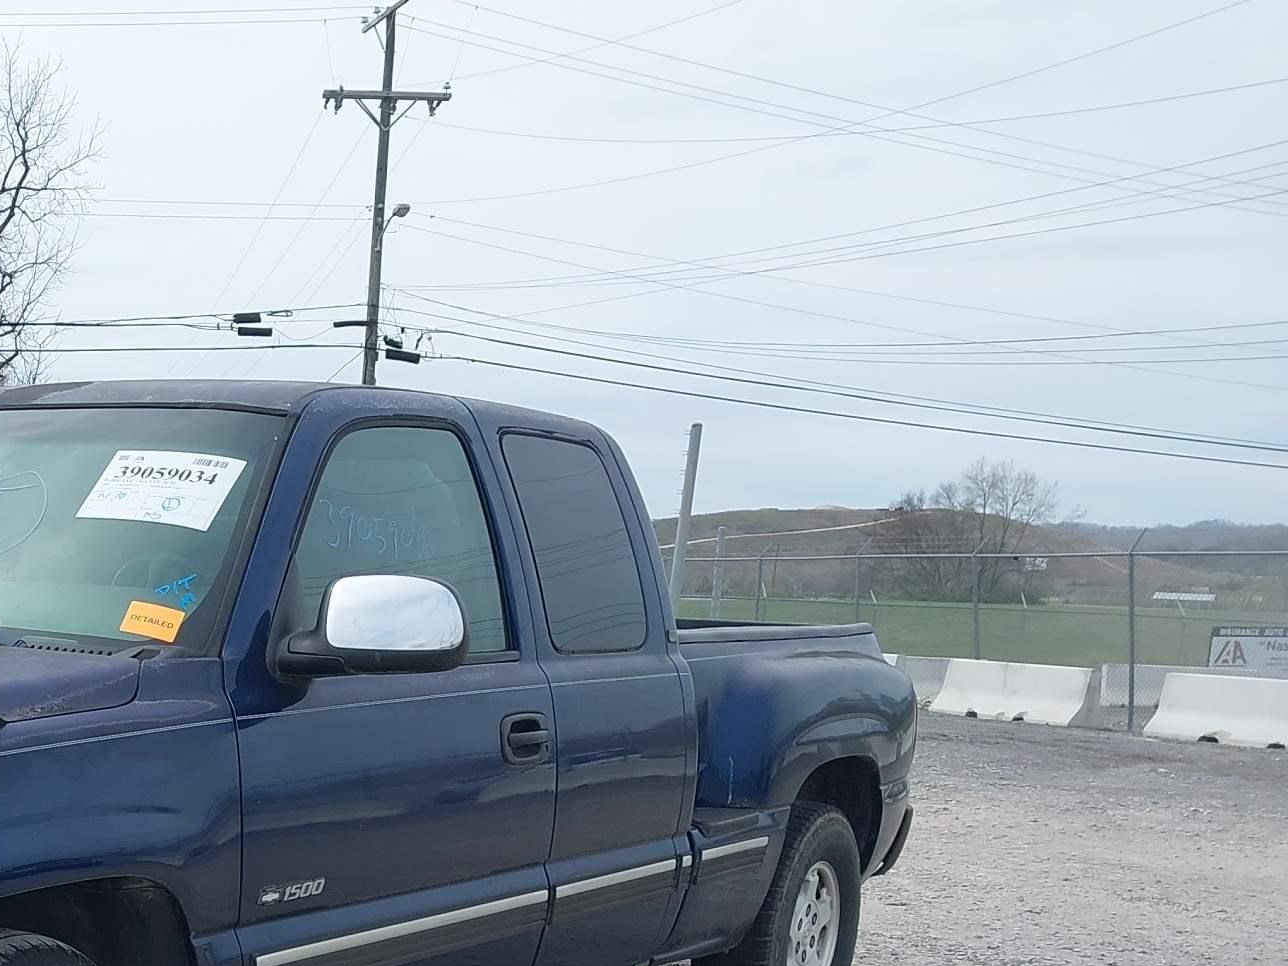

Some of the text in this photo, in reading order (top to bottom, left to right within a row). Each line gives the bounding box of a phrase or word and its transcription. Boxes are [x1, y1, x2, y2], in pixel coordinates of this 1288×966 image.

[113, 465, 219, 486] 39059034
[130, 614, 174, 629] DETAILED
[1219, 627, 1260, 636] INSURANCE
[283, 877, 325, 901] 1500
